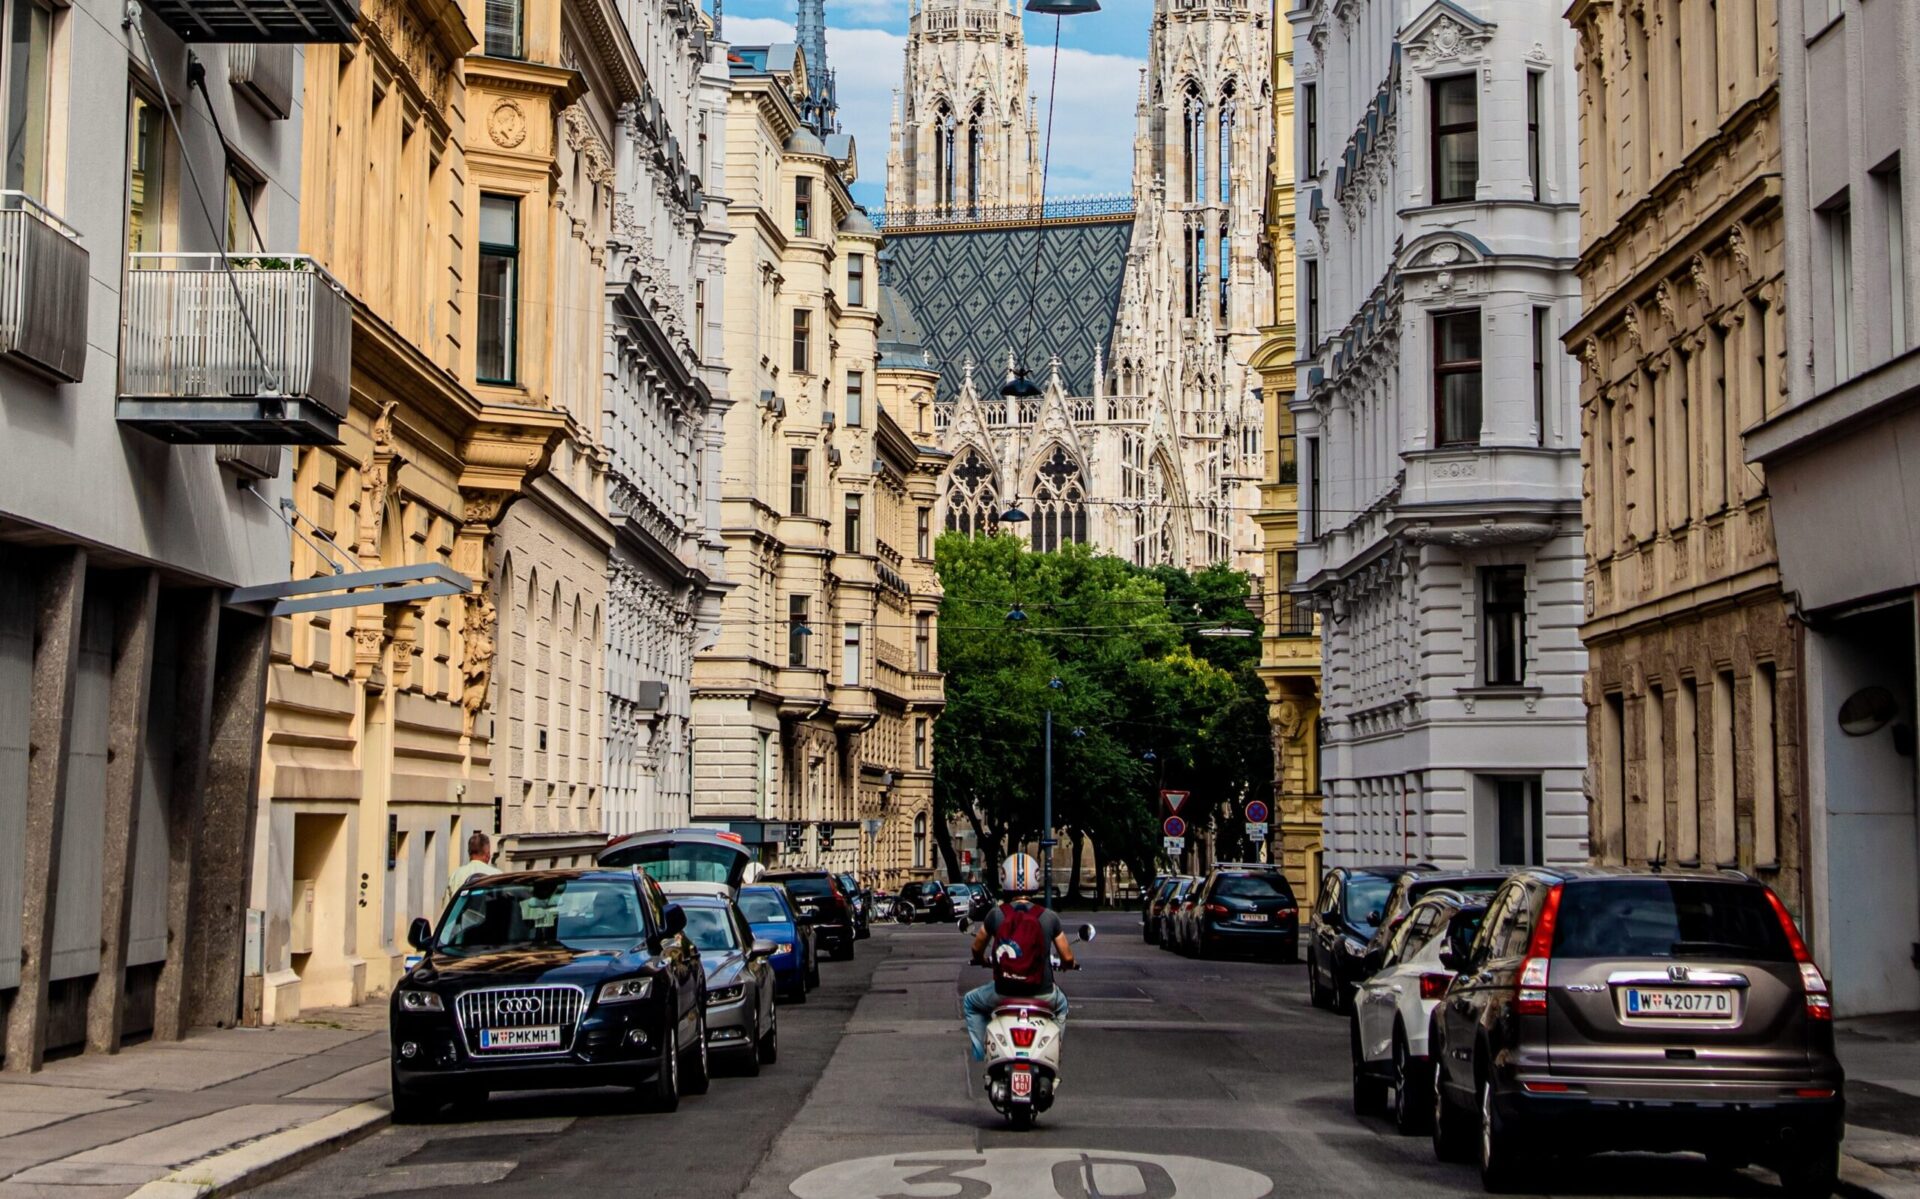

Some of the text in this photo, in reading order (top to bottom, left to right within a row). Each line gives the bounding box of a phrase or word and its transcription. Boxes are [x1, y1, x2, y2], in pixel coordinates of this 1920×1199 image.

[1640, 994, 1651, 1010] W
[1664, 994, 1713, 1010] 42077
[491, 1029, 556, 1044] W PMKMH 1
[876, 1158, 1177, 1199] 30
